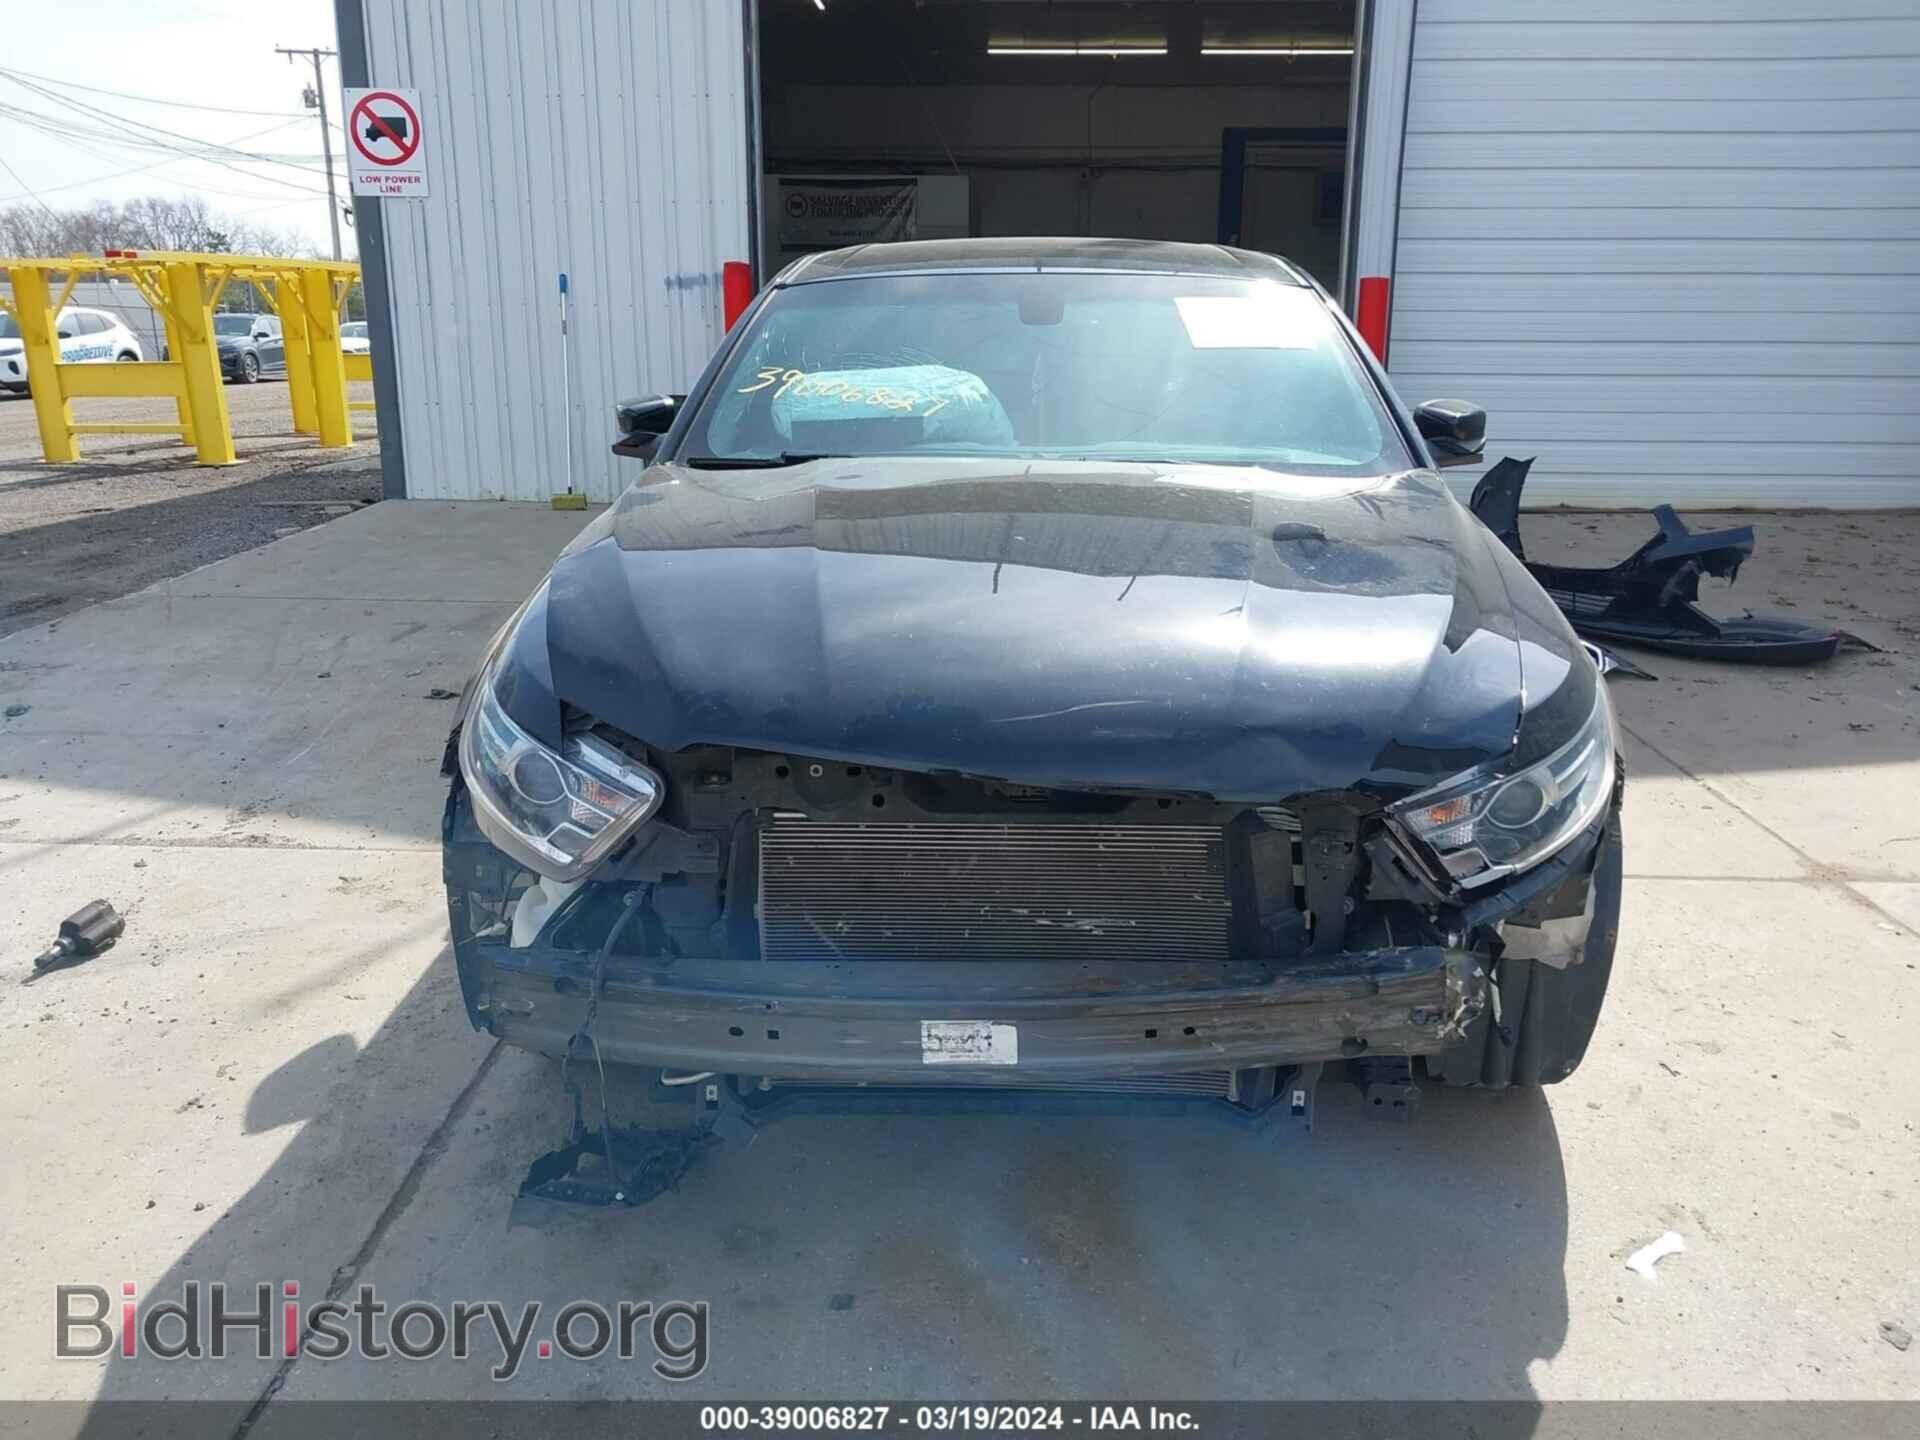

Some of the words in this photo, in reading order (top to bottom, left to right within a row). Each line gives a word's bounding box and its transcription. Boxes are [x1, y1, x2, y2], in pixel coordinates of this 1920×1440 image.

[359, 175, 381, 184] LOW
[384, 175, 421, 184] POWER
[379, 185, 402, 193] LINE
